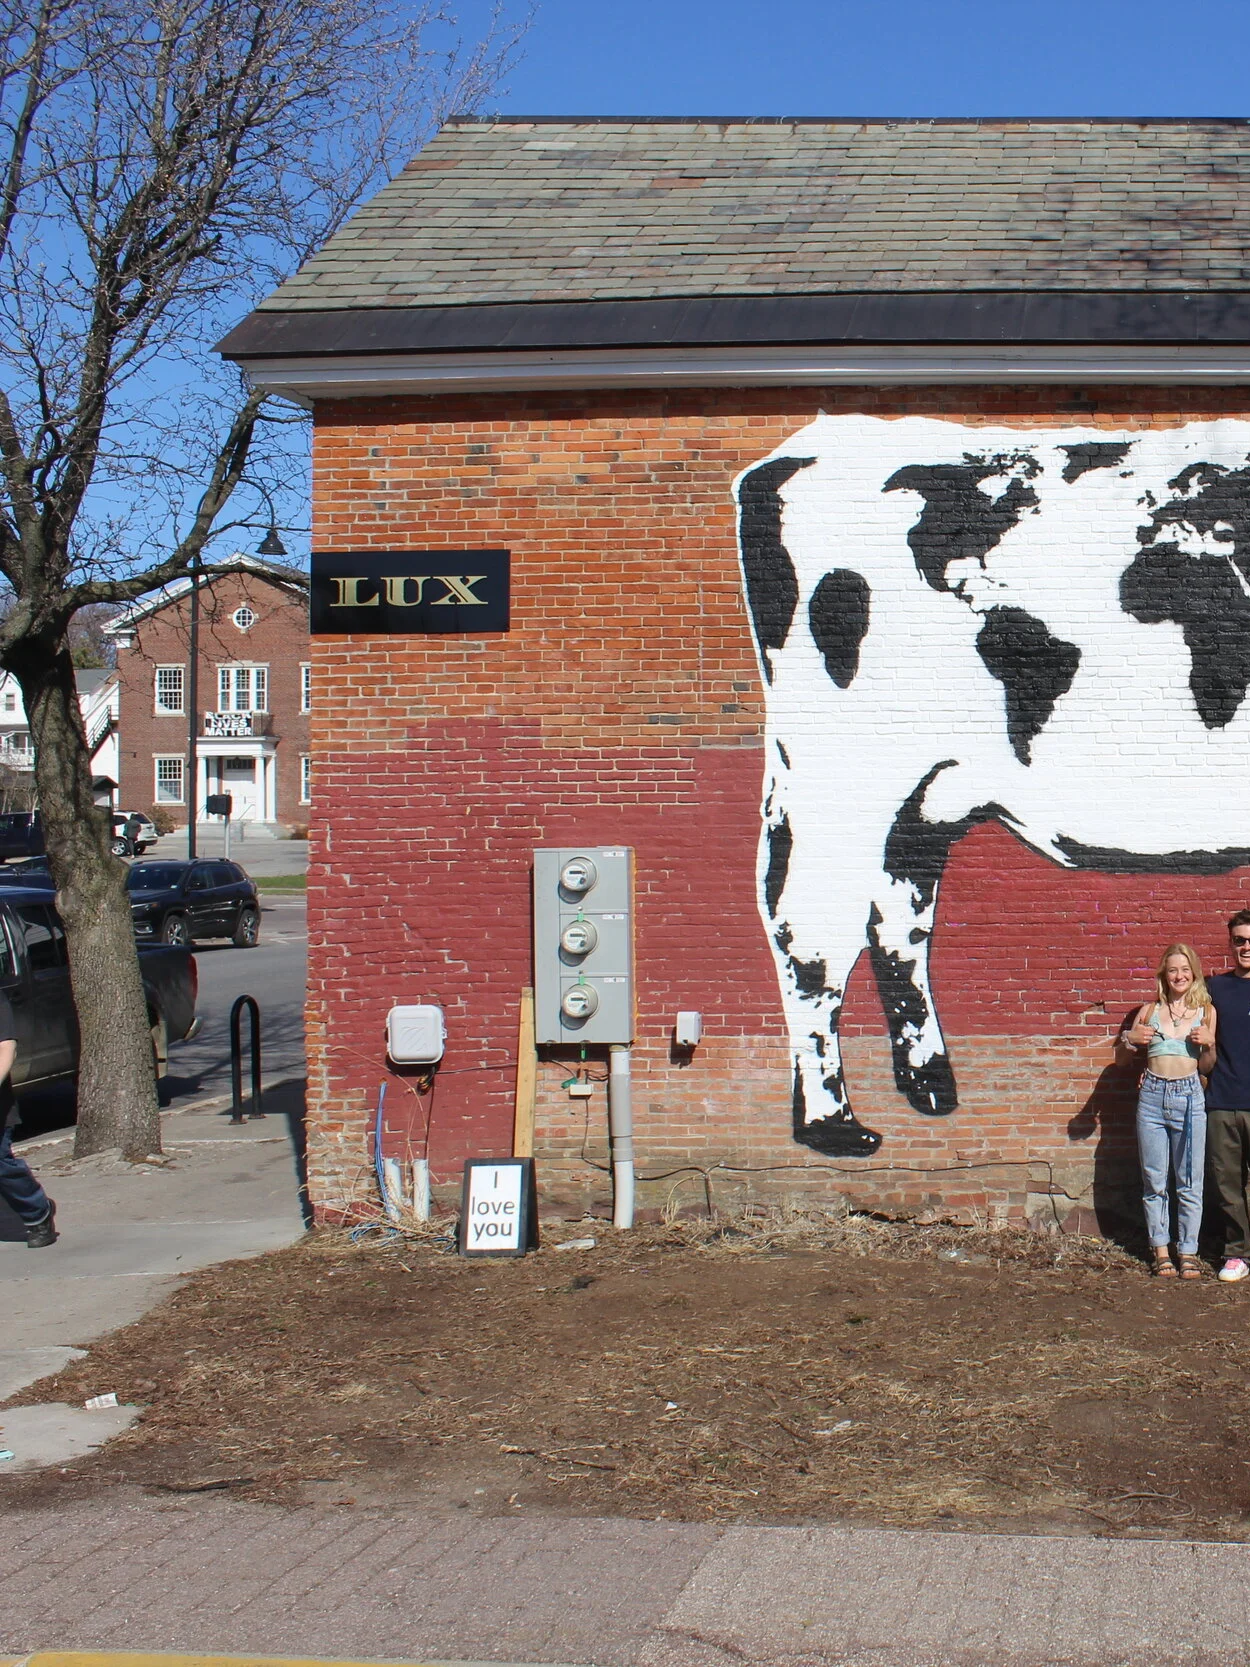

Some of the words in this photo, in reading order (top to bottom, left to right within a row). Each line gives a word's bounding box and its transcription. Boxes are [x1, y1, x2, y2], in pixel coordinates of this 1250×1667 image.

[329, 575, 489, 607] LUX
[205, 727, 252, 736] MATTER
[211, 719, 248, 728] LIVES
[471, 1196, 515, 1215] love
[473, 1222, 513, 1242] you
